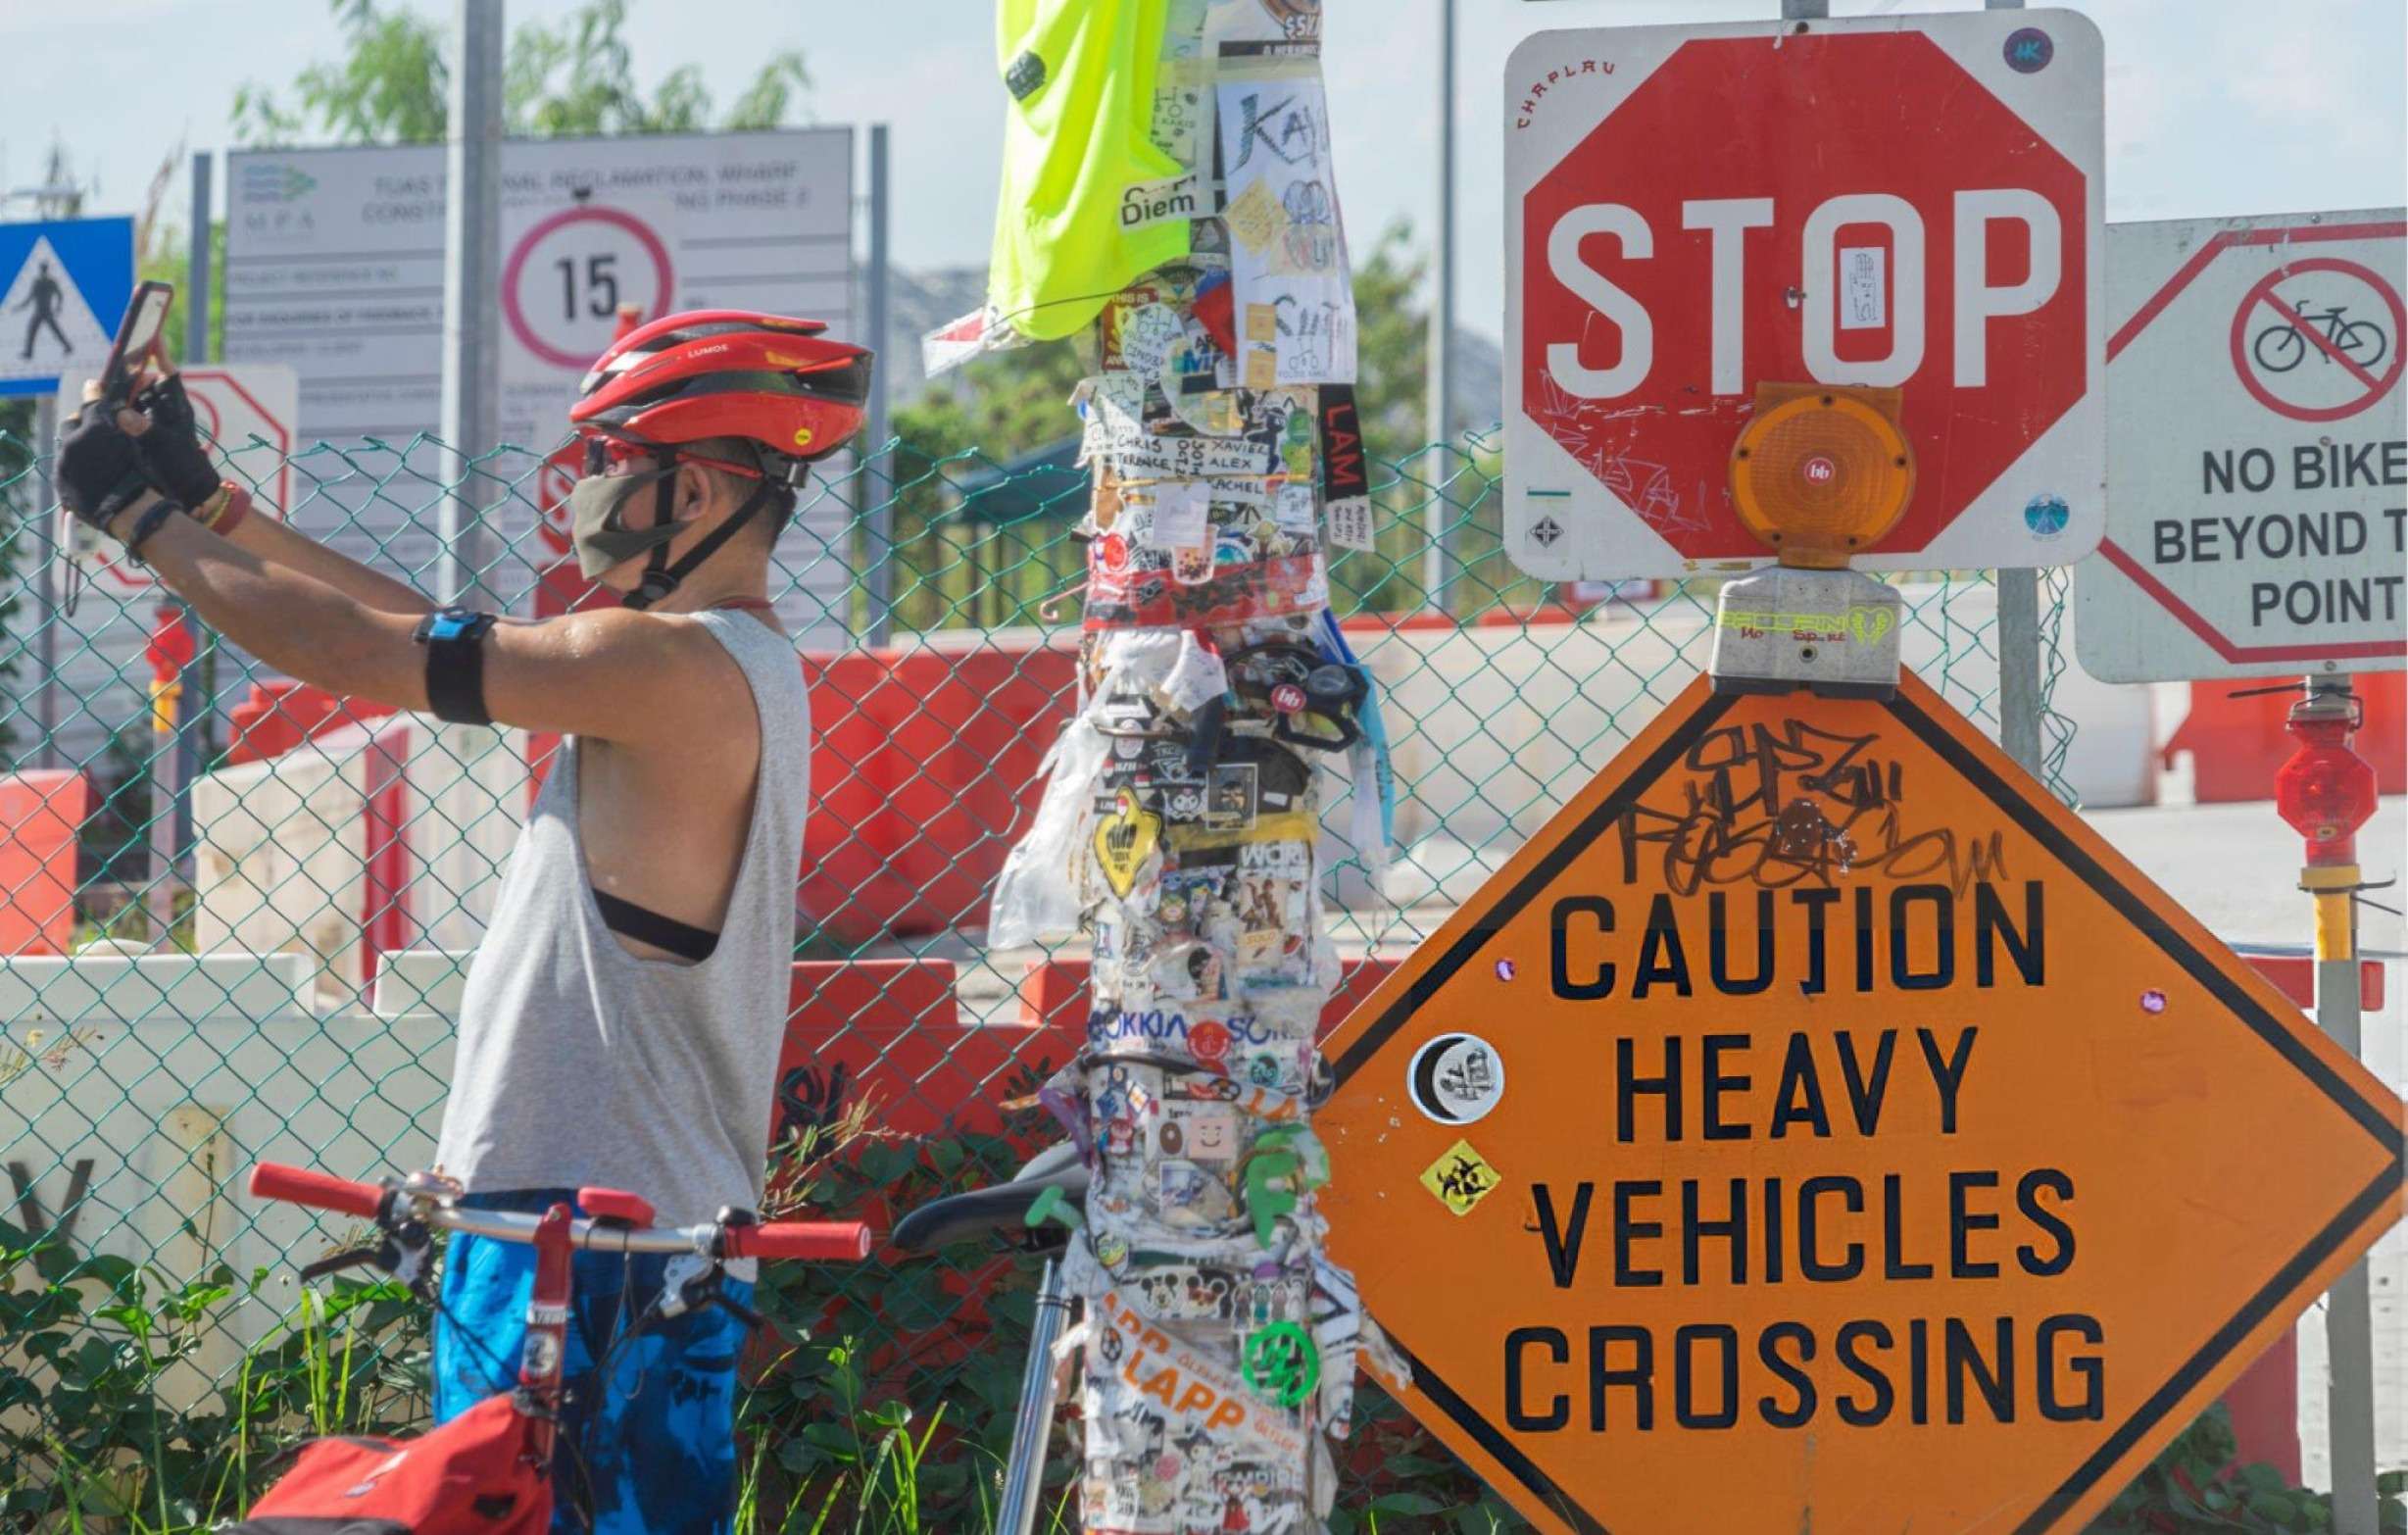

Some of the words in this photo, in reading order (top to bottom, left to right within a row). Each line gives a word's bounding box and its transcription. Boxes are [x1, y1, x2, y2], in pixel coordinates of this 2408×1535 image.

[1121, 194, 1195, 225] Diem
[554, 255, 618, 322] 15
[1546, 187, 2062, 399] STOP
[688, 344, 729, 359] LUMOS
[1118, 432, 1163, 454] CHRIS
[1209, 457, 1253, 470] ALEX
[1325, 403, 1362, 486] LAM
[2202, 447, 2276, 494] NO
[2153, 511, 2367, 564] BEYOND
[2251, 575, 2405, 627] POINT
[1549, 880, 2046, 1001] CAUTION
[1616, 1025, 1979, 1145] HEAVY
[1531, 1168, 2076, 1290] VEHICLES
[1123, 1348, 1247, 1430] LAPP
[1503, 1313, 2105, 1434] CROSSING
